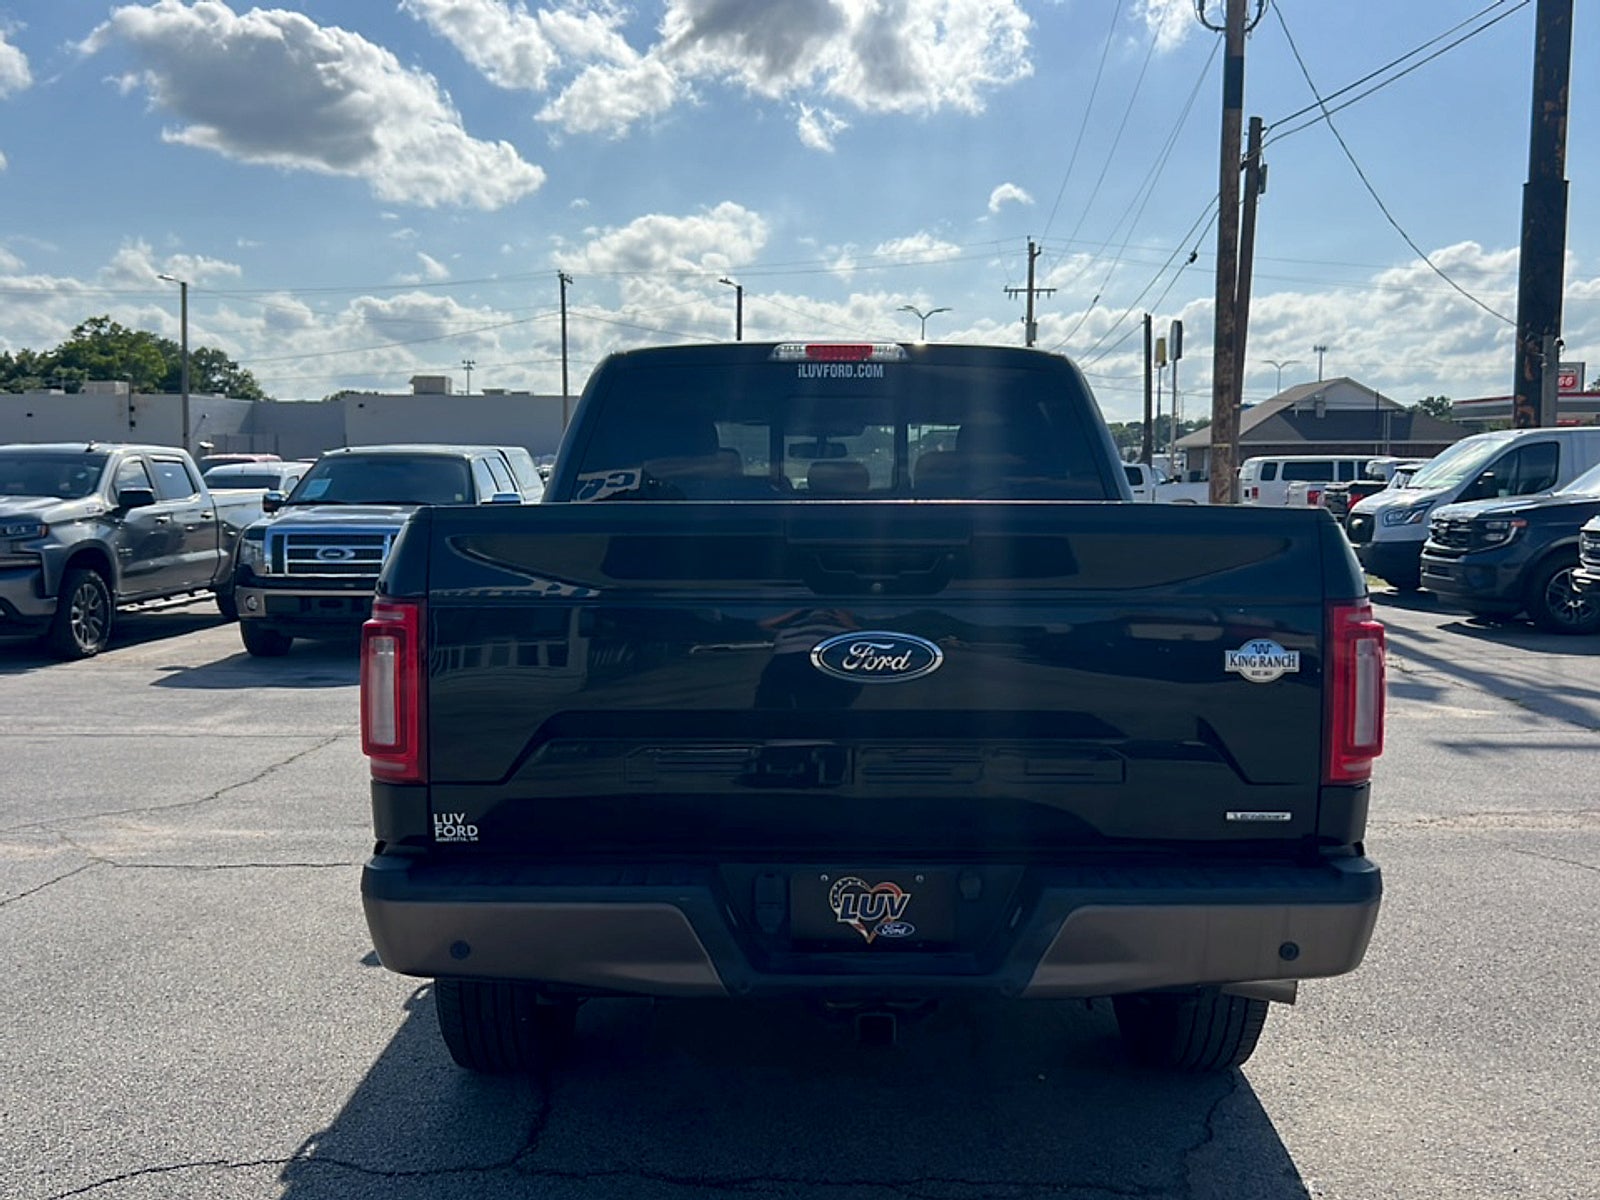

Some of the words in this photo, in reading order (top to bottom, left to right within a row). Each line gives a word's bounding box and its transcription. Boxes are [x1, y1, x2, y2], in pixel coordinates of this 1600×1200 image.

[842, 641, 912, 670] Ford
[1230, 653, 1257, 667] KING
[1259, 653, 1296, 668] RANCH
[433, 813, 465, 825] LUV
[435, 824, 478, 837] FORD
[838, 893, 912, 922] LUV
[881, 924, 908, 935] Ford
